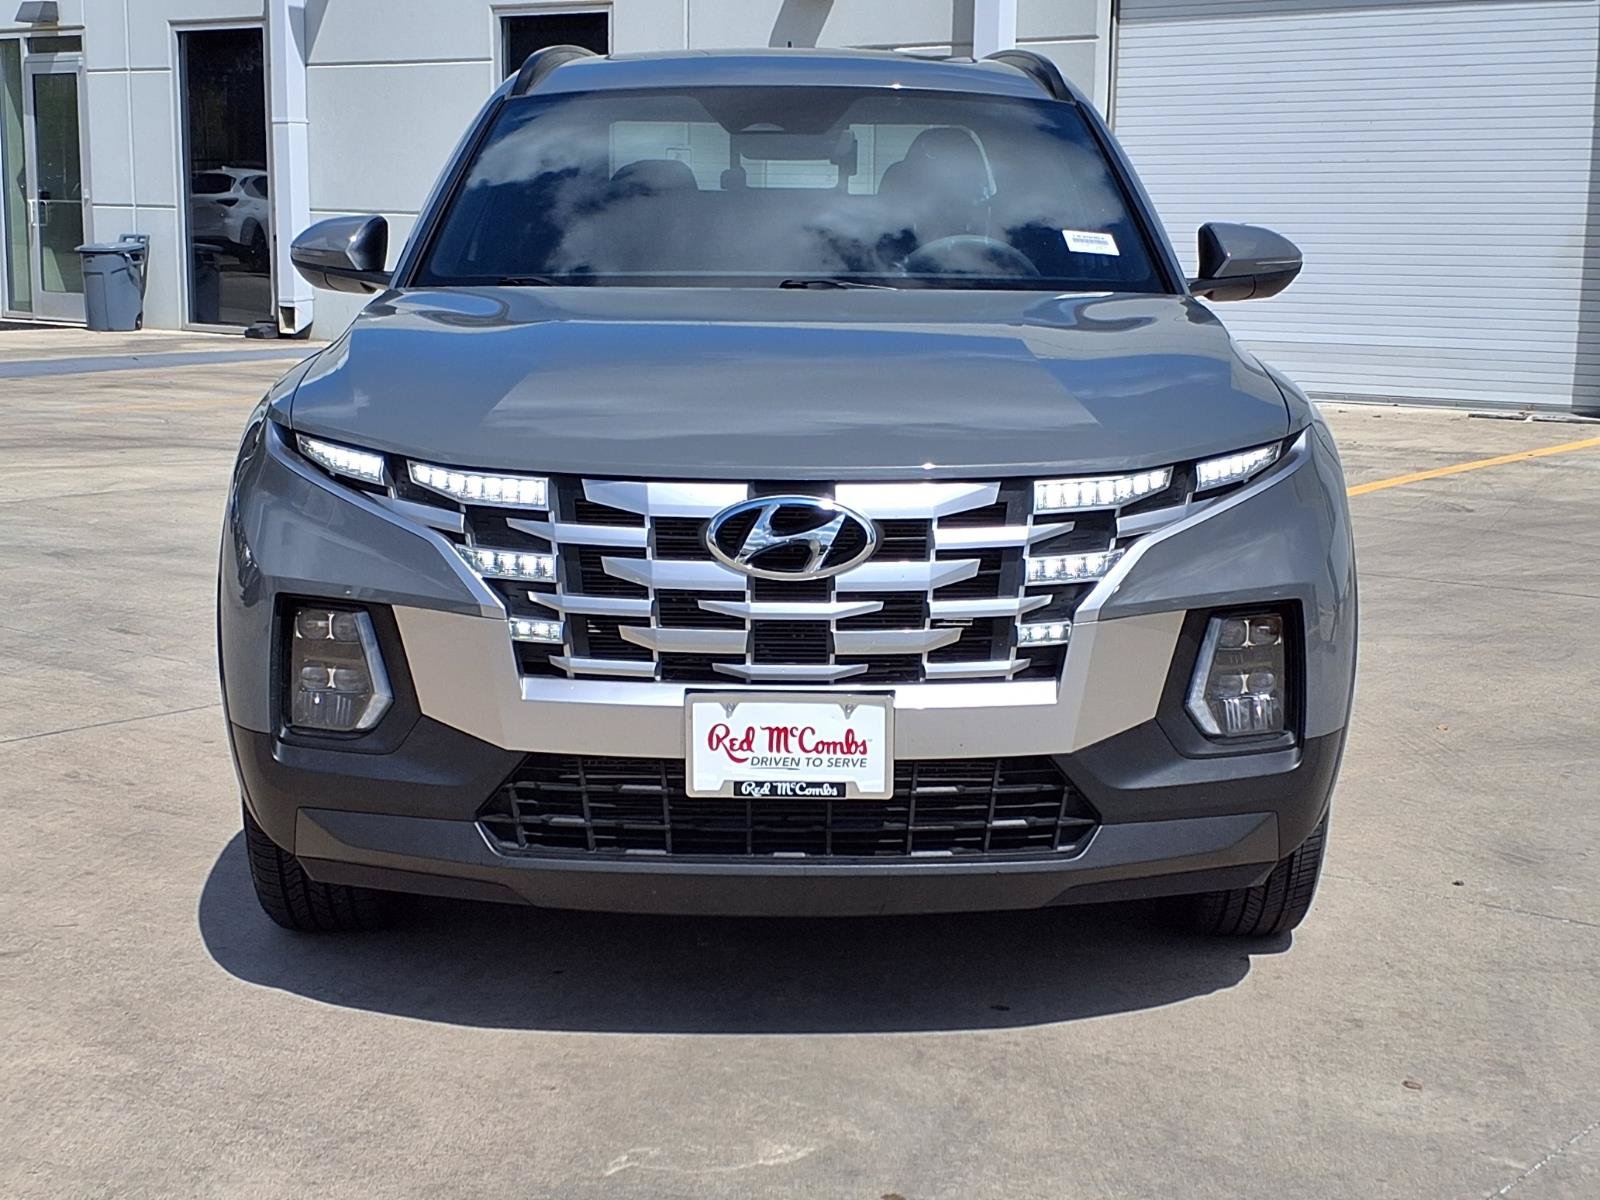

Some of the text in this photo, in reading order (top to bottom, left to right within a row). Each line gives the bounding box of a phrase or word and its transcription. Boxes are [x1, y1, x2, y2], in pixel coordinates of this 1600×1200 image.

[708, 723, 868, 763] Red McCombs
[751, 756, 867, 768] DRIVEN TO SERVE
[741, 781, 837, 796] Red McCombs
